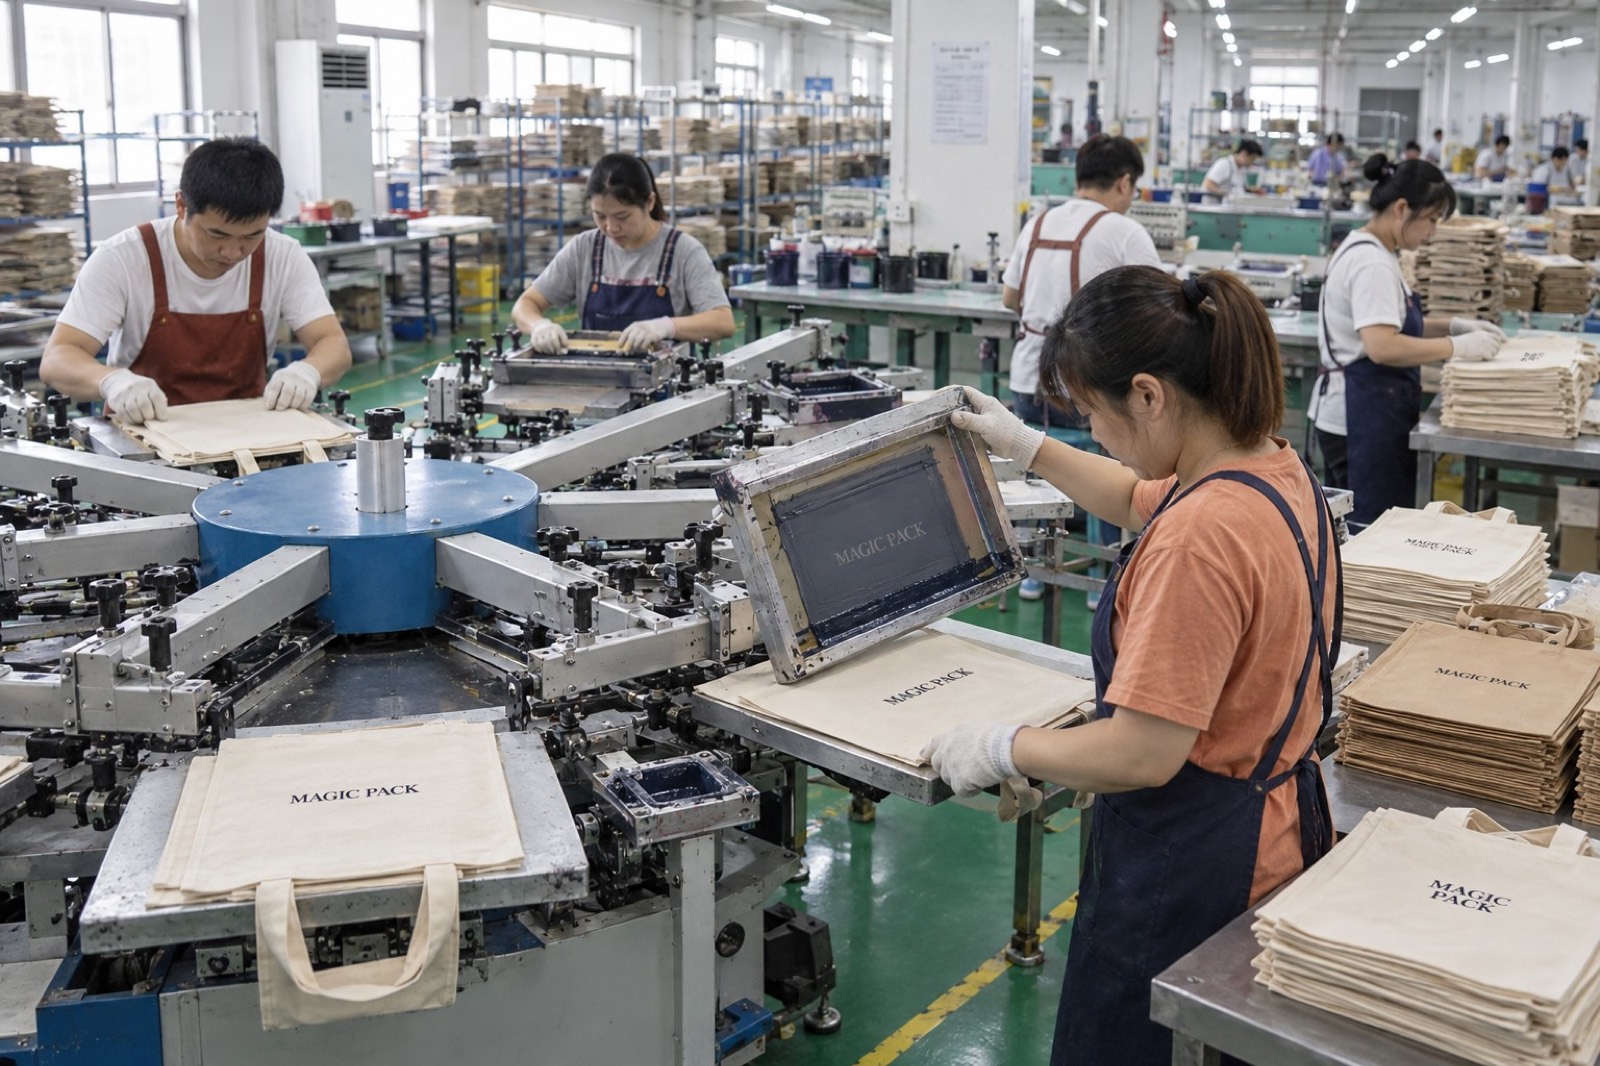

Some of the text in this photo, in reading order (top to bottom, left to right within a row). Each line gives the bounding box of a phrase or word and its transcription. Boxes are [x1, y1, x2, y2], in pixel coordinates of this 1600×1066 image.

[834, 521, 927, 566] MAGIC PACK
[882, 667, 974, 706] MAGIC PACK
[1434, 667, 1532, 690] MAGIC PACK
[289, 783, 420, 805] MAGIC PACK
[1427, 879, 1511, 907] MAGIC
[1429, 890, 1496, 914] PACK
